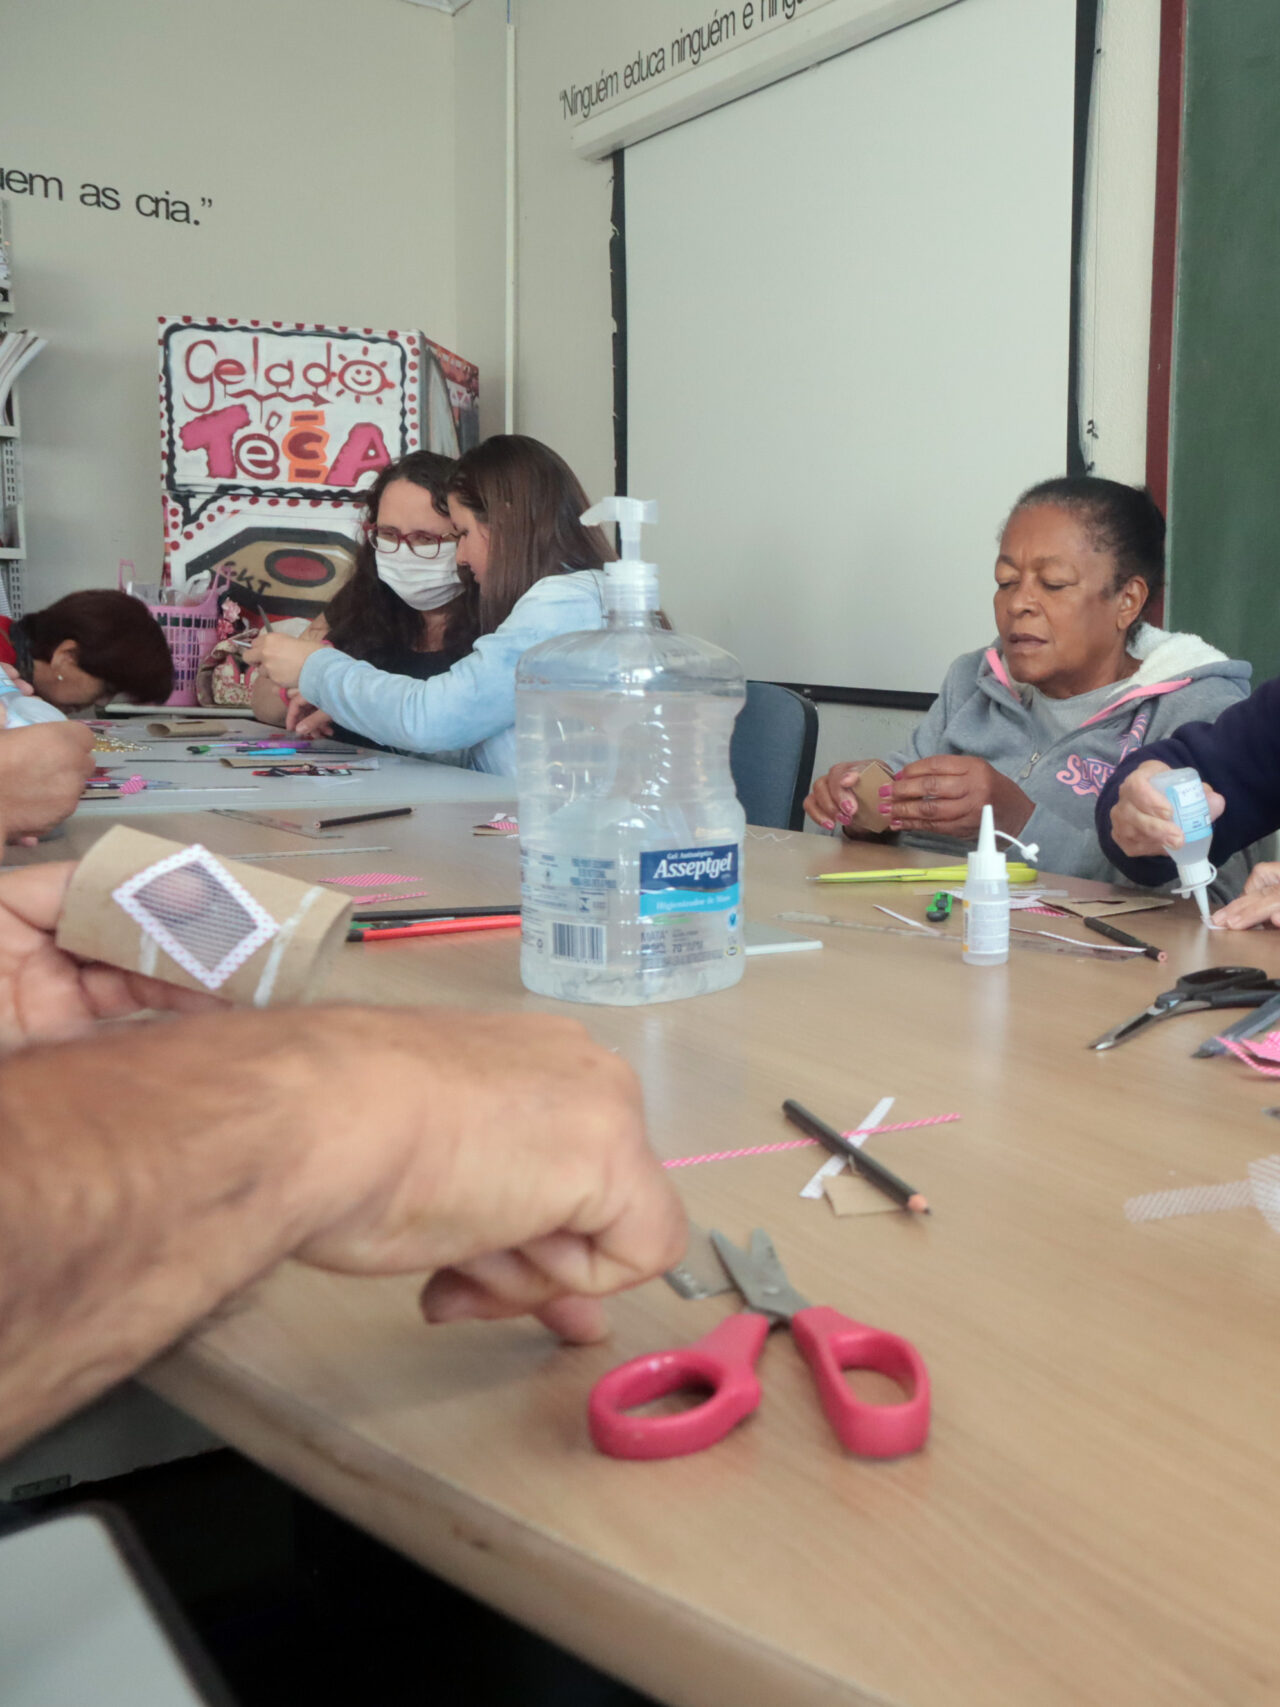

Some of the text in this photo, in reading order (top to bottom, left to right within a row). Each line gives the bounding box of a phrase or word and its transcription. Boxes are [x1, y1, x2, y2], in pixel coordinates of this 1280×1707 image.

[623, 48, 665, 89] educa
[671, 9, 735, 66] ninguém
[742, 2, 754, 30] e
[79, 183, 120, 210] as
[653, 852, 732, 880] Asseptgel
